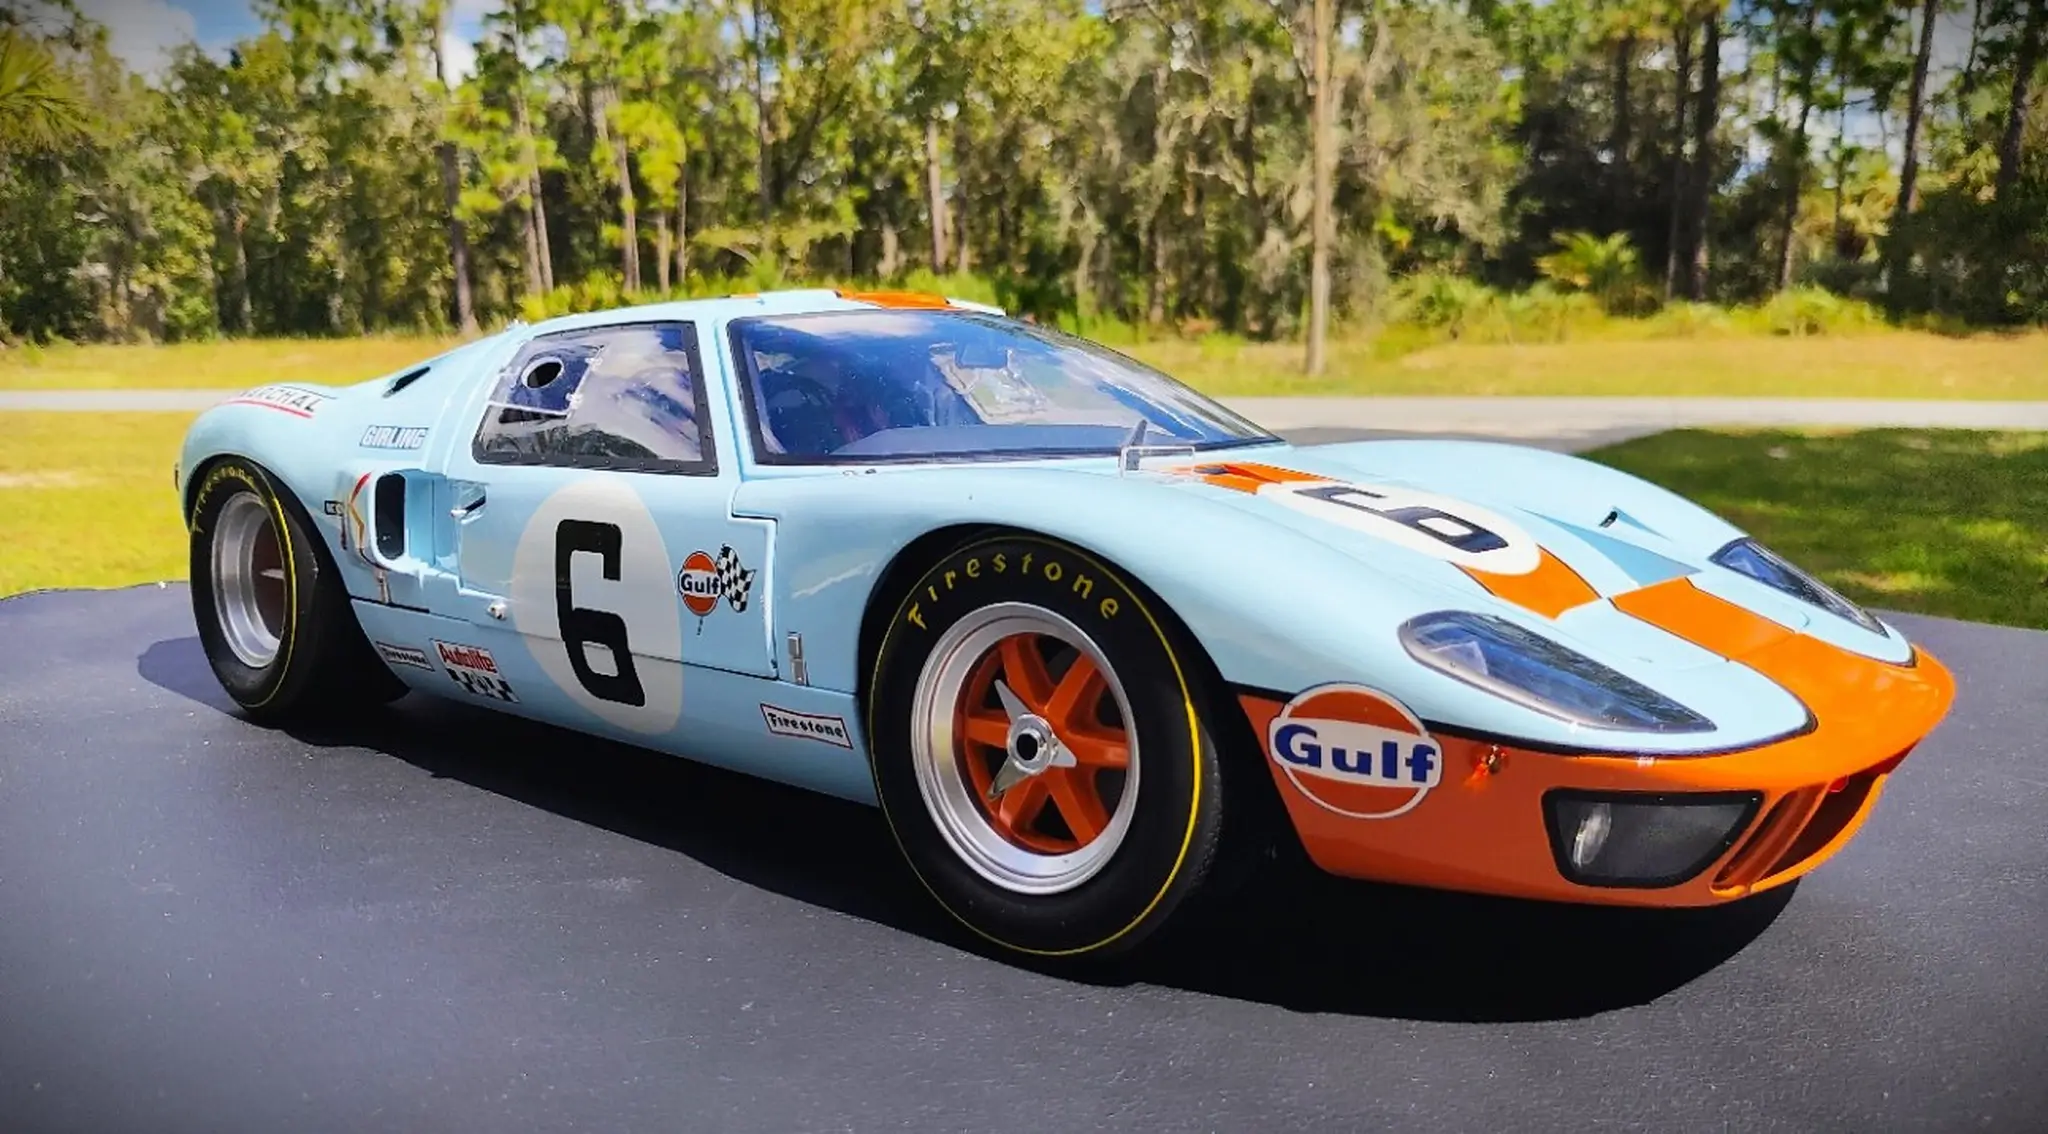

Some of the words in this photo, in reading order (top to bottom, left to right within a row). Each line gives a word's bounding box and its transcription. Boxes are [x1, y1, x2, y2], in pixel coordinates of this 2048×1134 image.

[362, 425, 427, 449] GIRLING
[1293, 486, 1509, 554] 6
[680, 575, 721, 597] Gulf
[907, 552, 1120, 630] Firestone
[556, 519, 646, 707] 6
[437, 642, 498, 674] Autolite
[768, 712, 844, 738] Firestone
[1274, 723, 1438, 783] Gulf
